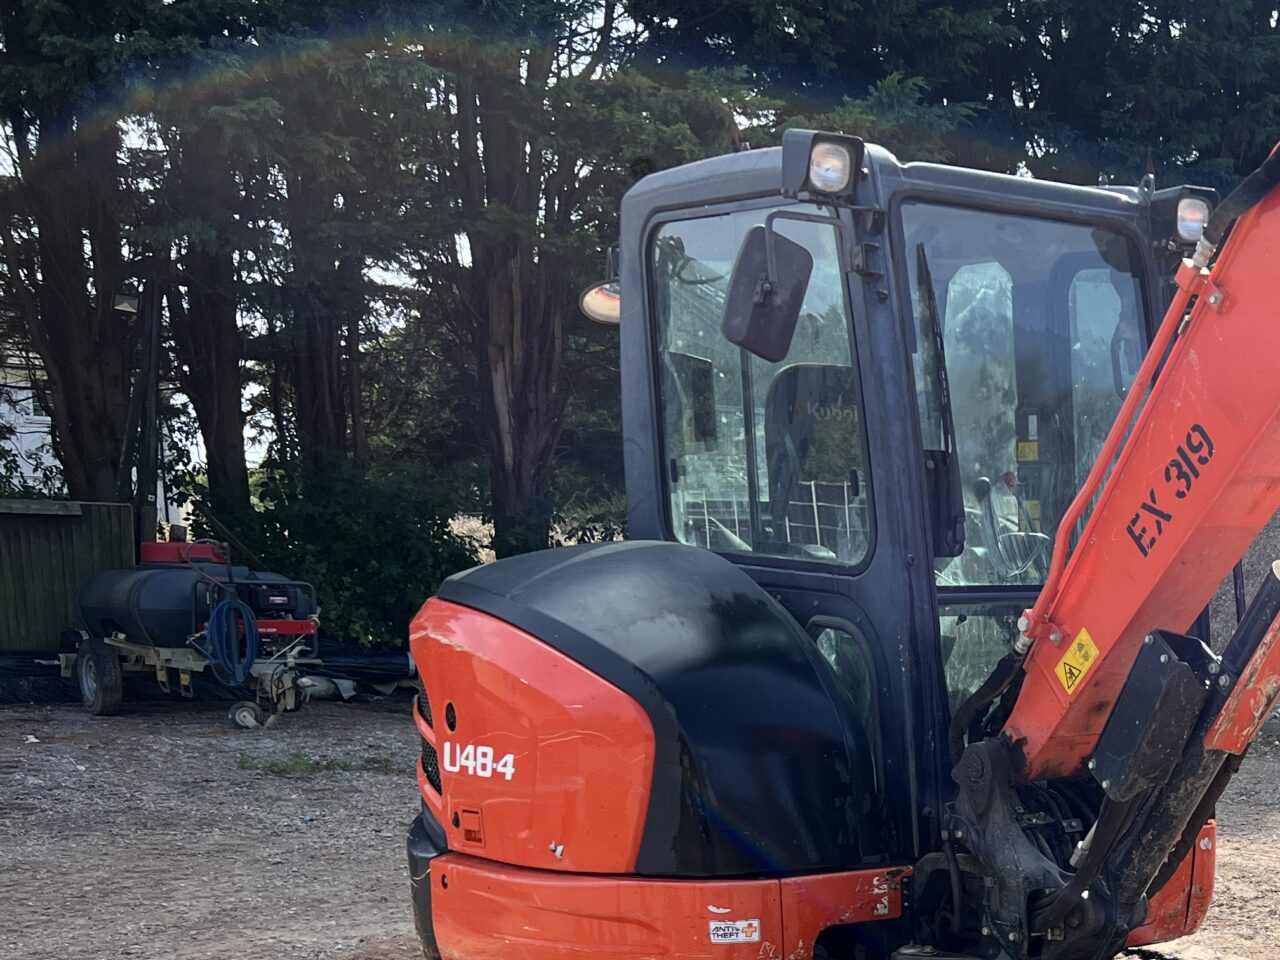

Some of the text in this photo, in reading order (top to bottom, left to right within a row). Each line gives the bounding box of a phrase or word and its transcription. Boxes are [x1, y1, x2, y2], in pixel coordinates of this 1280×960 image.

[1126, 424, 1214, 558] EX 319
[443, 741, 516, 780] U48-4
